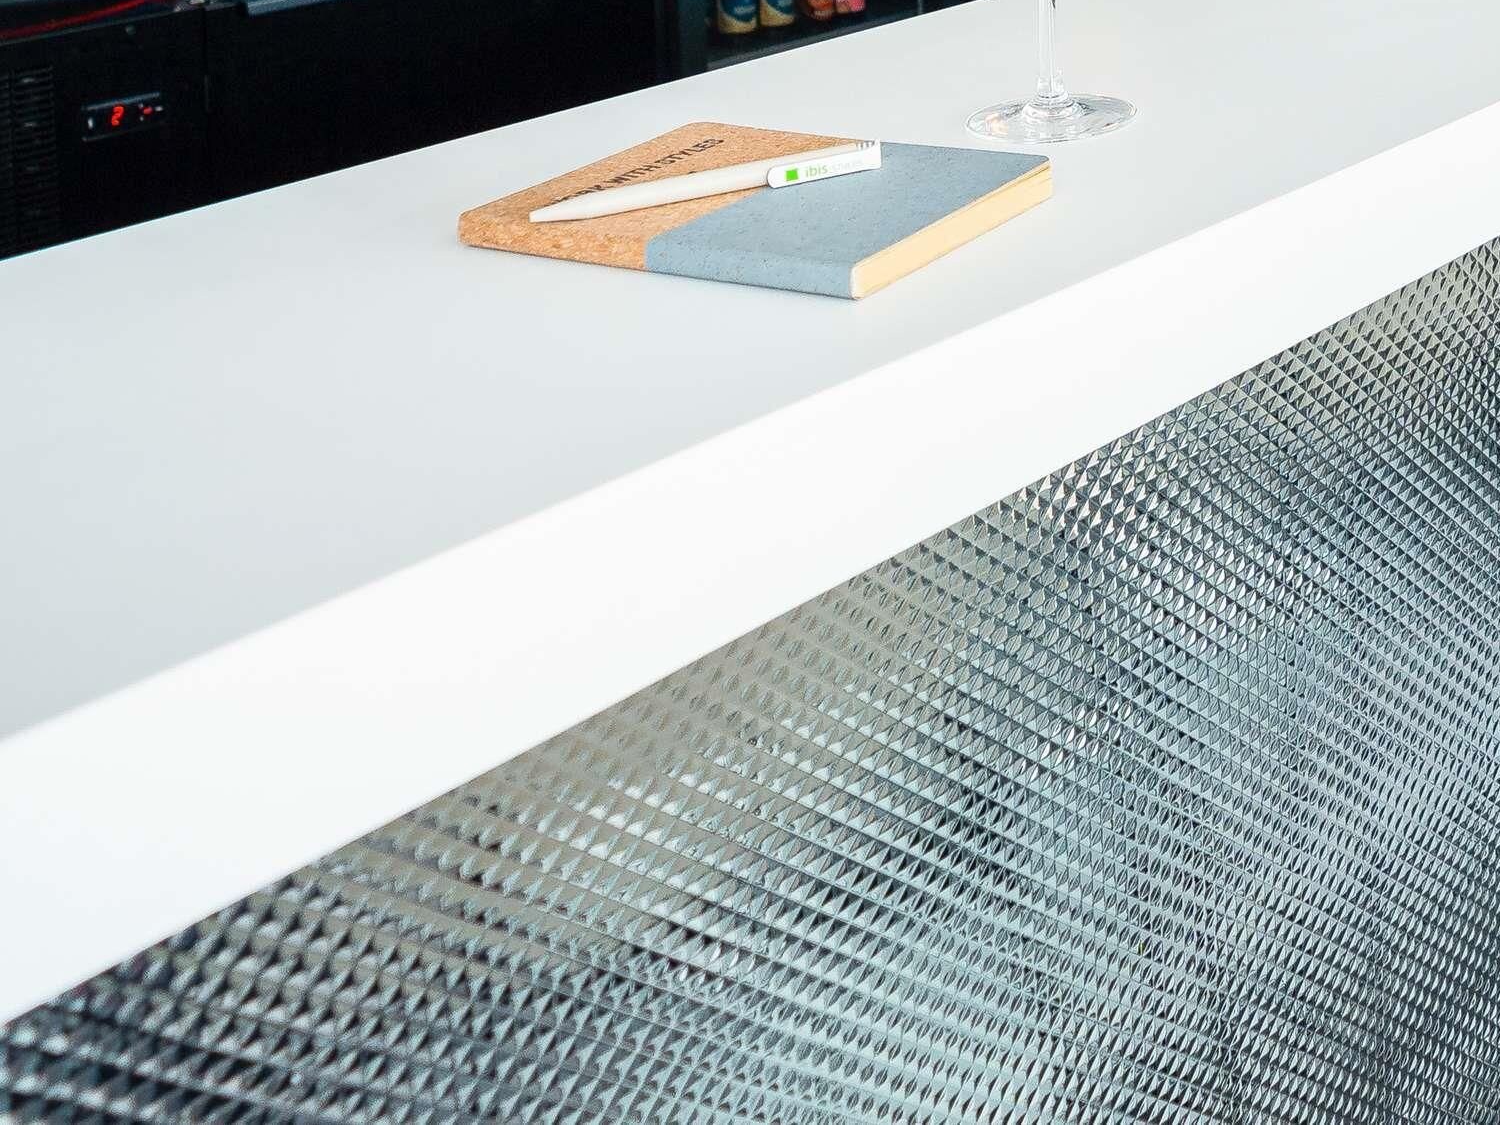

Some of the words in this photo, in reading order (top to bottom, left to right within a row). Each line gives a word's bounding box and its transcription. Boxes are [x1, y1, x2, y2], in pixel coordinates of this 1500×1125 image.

[603, 162, 657, 186] WITH
[655, 138, 724, 166] STYLES
[805, 163, 828, 178] ibis
